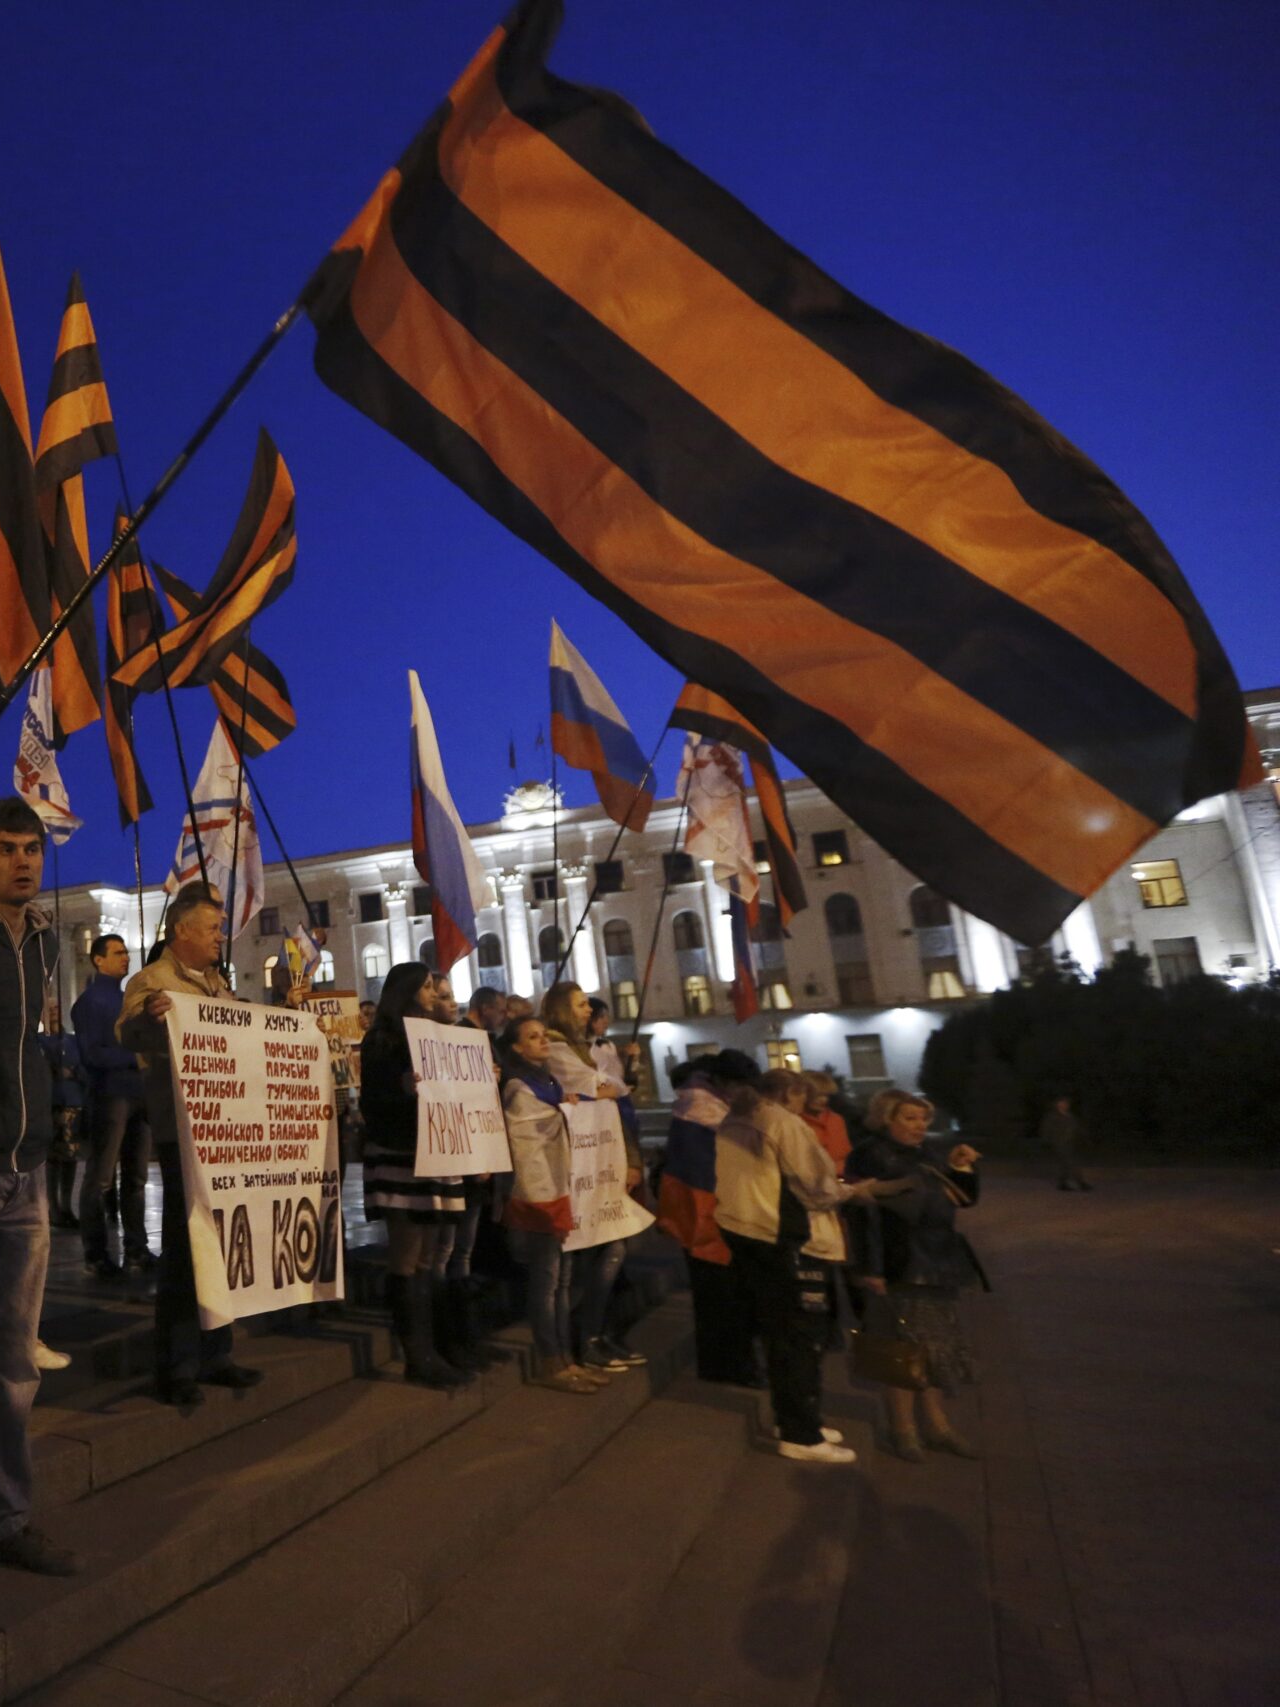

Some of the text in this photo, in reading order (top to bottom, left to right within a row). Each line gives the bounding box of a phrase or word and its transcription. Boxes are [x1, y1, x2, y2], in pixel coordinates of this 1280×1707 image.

[199, 1003, 252, 1027] КИЕВСКУЮ
[264, 1014, 304, 1033] ХУНТУ:
[182, 1032, 227, 1053] КЛИЧКО
[264, 1041, 319, 1061] ПОРОШЕНКО
[181, 1054, 236, 1075] ЯЦЕНЮКА
[266, 1061, 310, 1080] ПАРУБИЯ
[180, 1079, 246, 1099] ТЯГНИБОКА
[266, 1083, 320, 1101] ТУРЧИНОВА
[266, 1103, 334, 1121] ТИМОШЕНКО
[269, 1123, 320, 1141] БАЛАШОВА
[427, 1101, 472, 1155] КРЫМ
[273, 1143, 310, 1163] (ОБОИХ)
[212, 1175, 236, 1191] ВСЕХ
